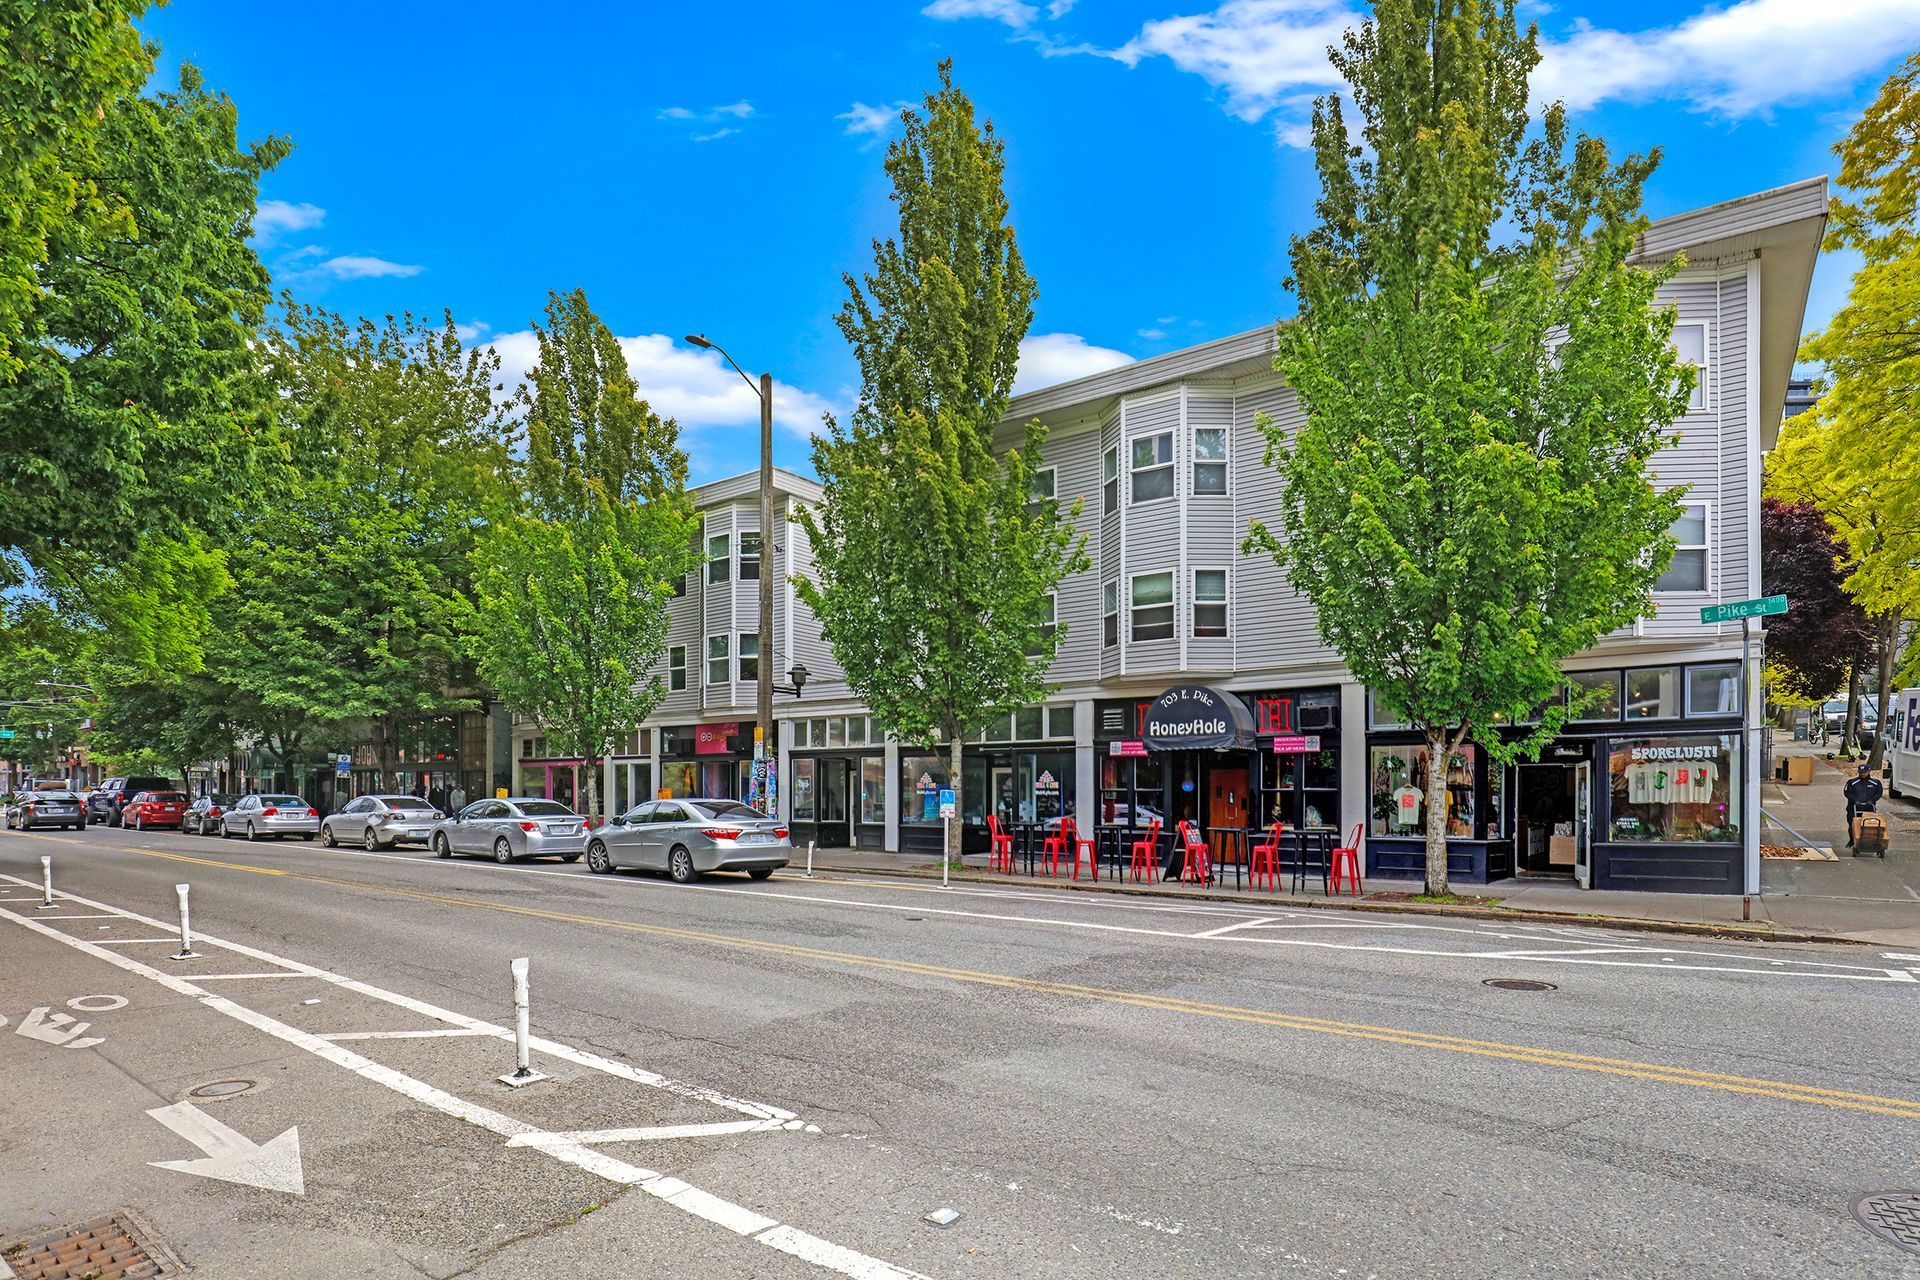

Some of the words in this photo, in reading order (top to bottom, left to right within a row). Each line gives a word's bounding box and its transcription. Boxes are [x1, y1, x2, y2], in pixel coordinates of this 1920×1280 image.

[1704, 612, 1711, 620] E
[1717, 605, 1747, 618] Pike
[1755, 603, 1767, 613] St
[1768, 596, 1785, 604] 1400
[1160, 692, 1178, 708] 703
[1181, 689, 1190, 699] E.
[1193, 690, 1214, 707] Pike
[1150, 718, 1226, 736] HoneyHole
[1631, 745, 1718, 760] SPORELUST!
